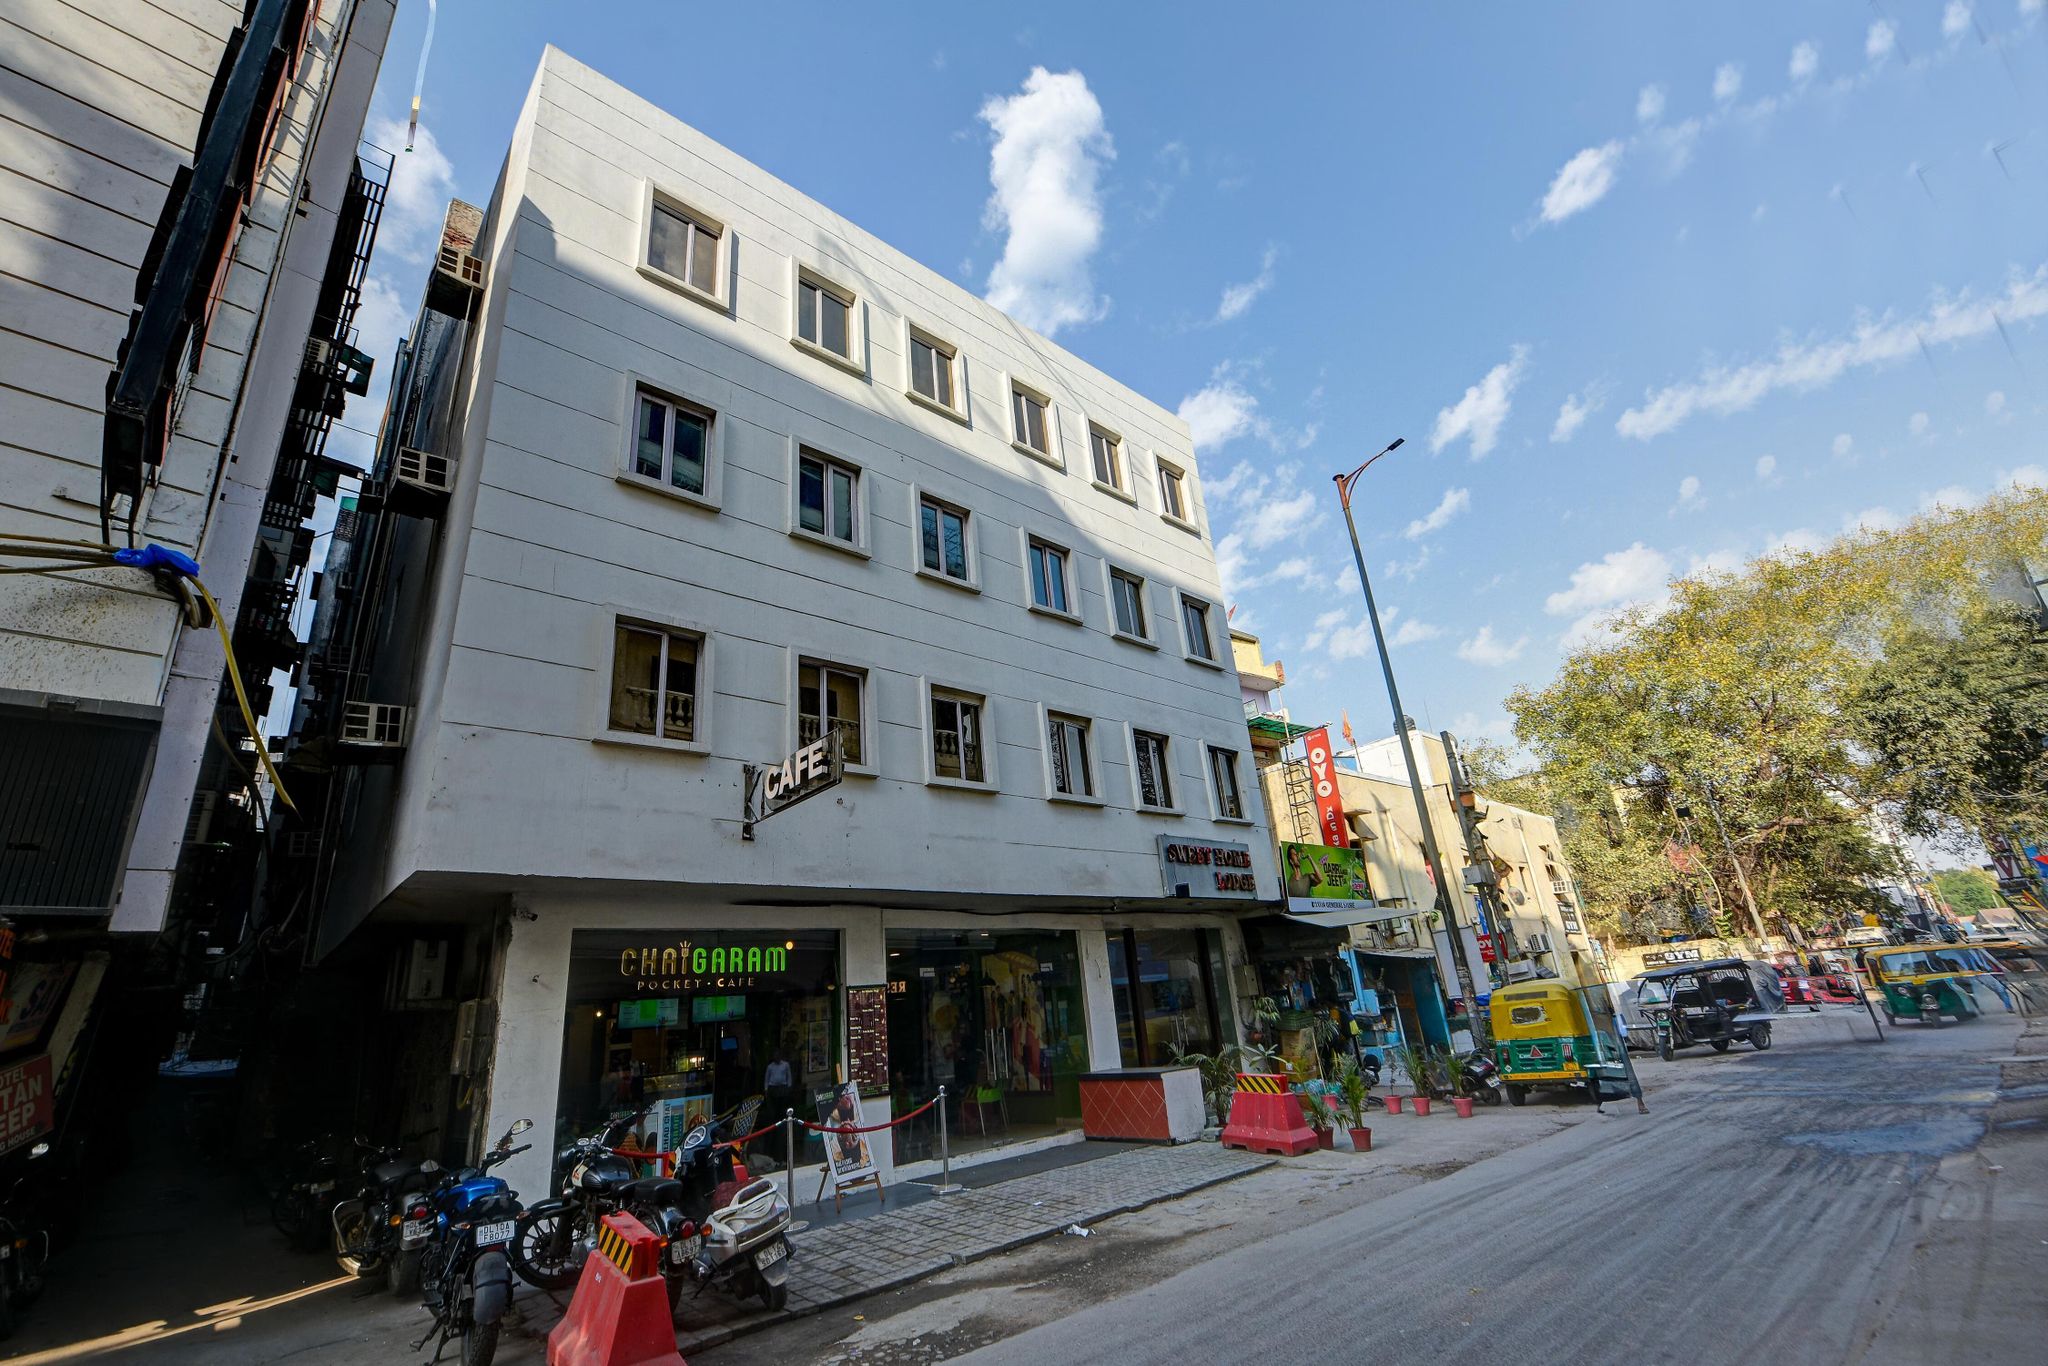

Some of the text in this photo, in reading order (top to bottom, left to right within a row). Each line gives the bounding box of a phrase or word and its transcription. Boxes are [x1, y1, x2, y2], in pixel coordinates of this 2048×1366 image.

[764, 740, 824, 800] CAFE
[1311, 747, 1333, 798] OYO
[1167, 843, 1252, 868] SWEET HOME
[1215, 871, 1256, 891] LODGE
[1478, 939, 1493, 949] OY
[1664, 949, 1700, 961] GYM
[637, 977, 755, 991] POCKET CAFE
[8, 1126, 37, 1148] HOUSE
